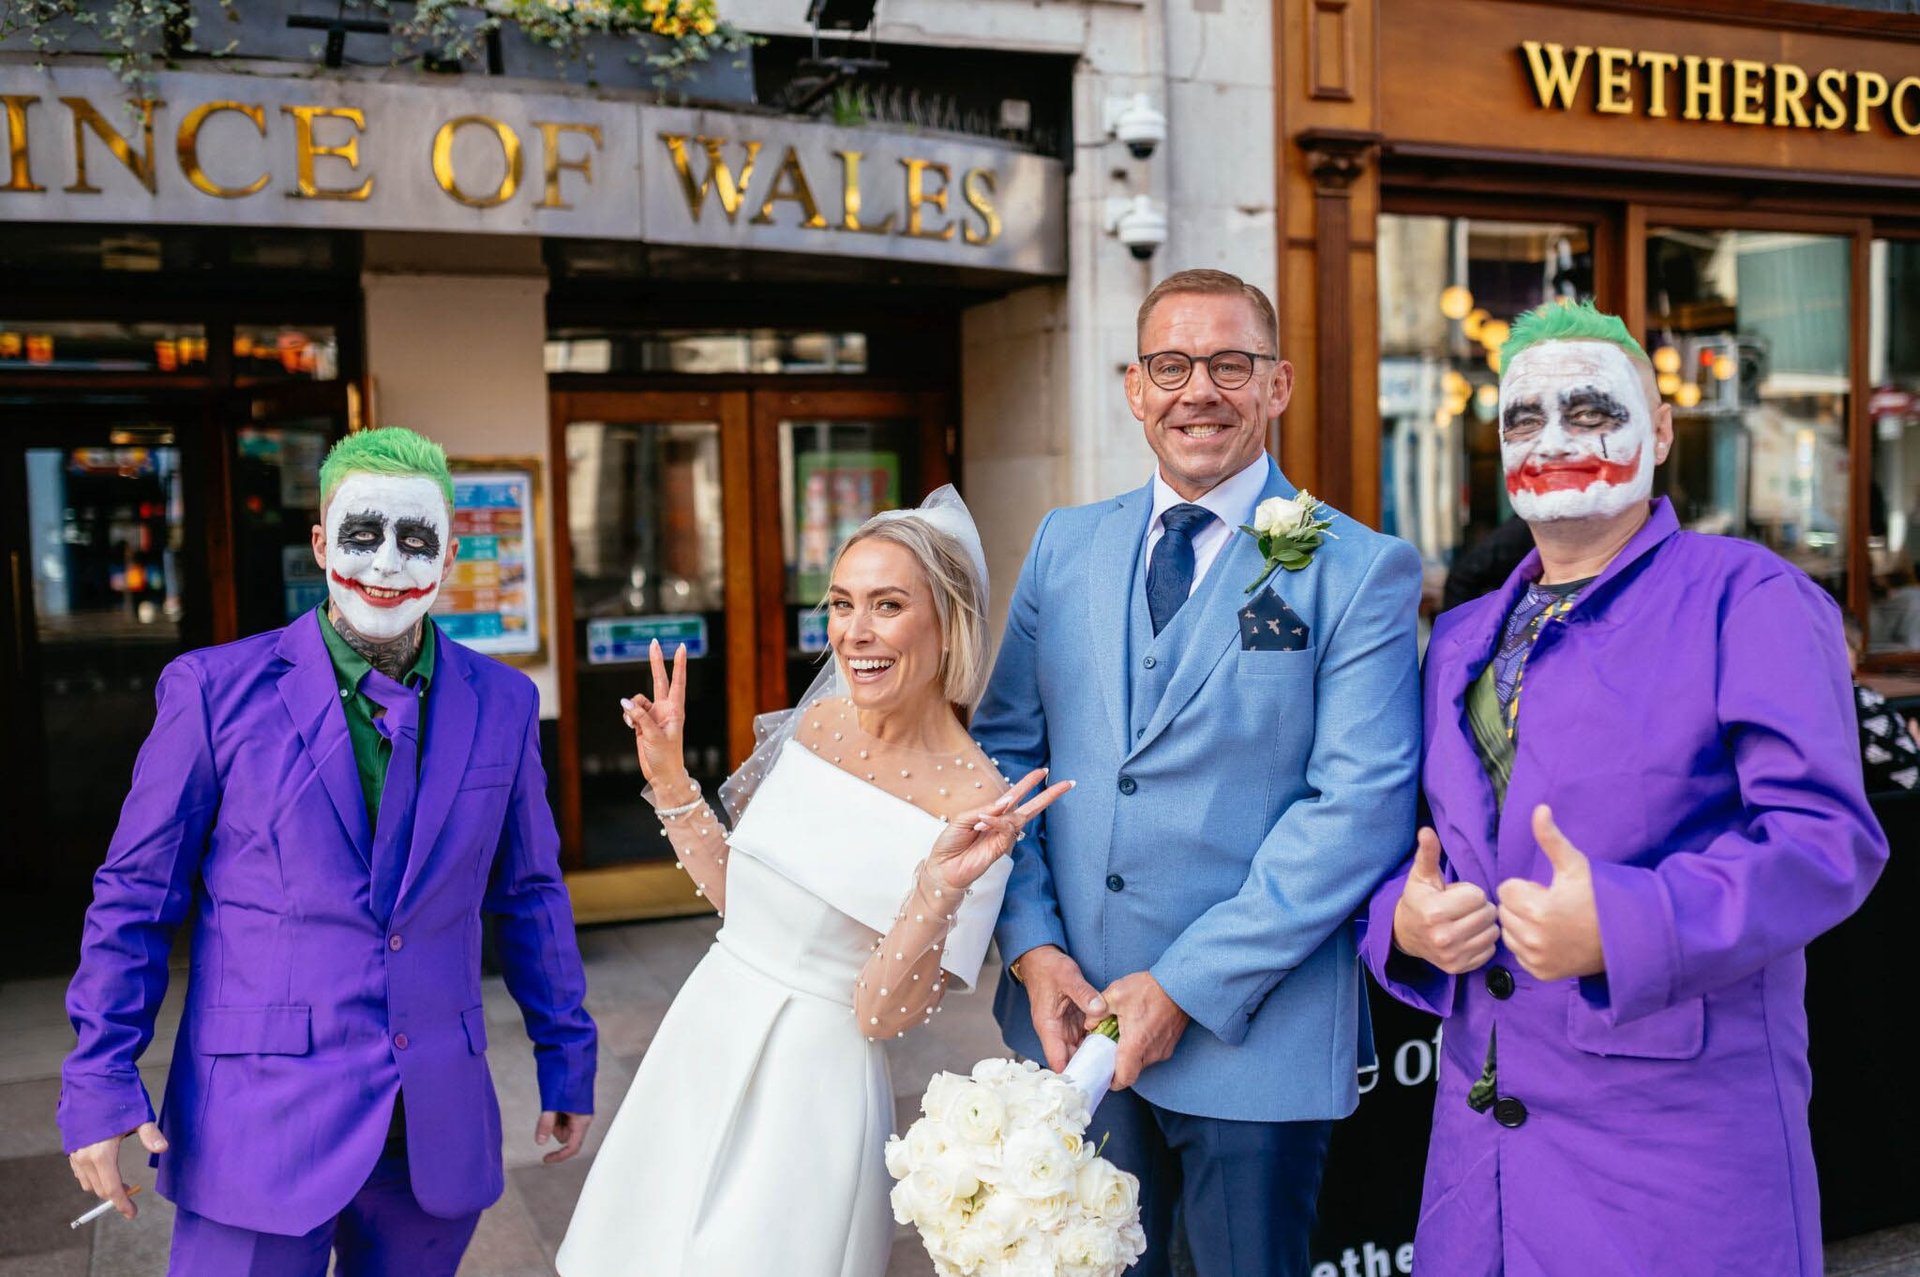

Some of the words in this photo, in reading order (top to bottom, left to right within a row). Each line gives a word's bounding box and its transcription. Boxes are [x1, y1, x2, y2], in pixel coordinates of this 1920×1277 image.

[0, 94, 374, 200] INCE
[431, 114, 604, 210] OF
[658, 131, 1002, 247] WALES
